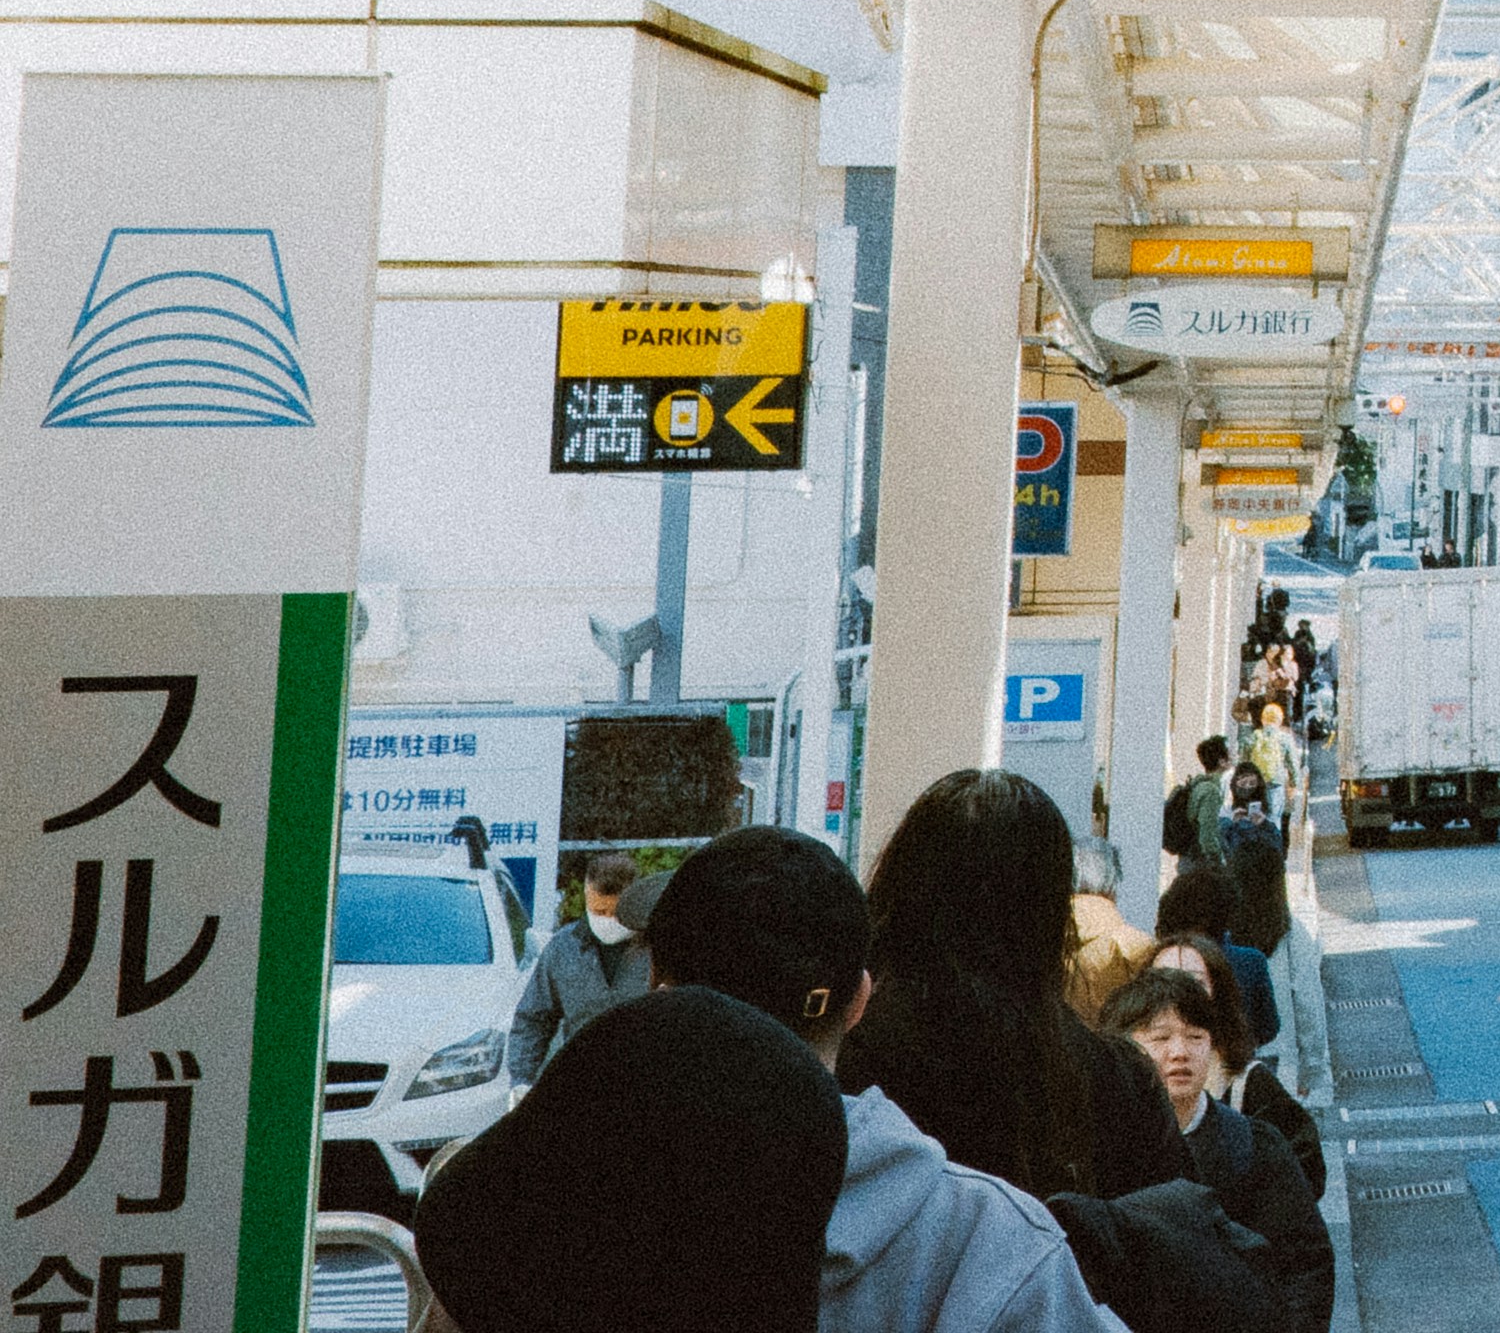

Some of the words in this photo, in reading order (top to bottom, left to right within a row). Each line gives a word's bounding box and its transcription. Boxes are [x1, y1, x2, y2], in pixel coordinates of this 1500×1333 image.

[1183, 308, 1313, 335] スルガ銀行
[621, 327, 743, 346] PARKING
[563, 384, 648, 463] 満
[1014, 484, 1061, 507] 4h
[1018, 677, 1062, 721] P
